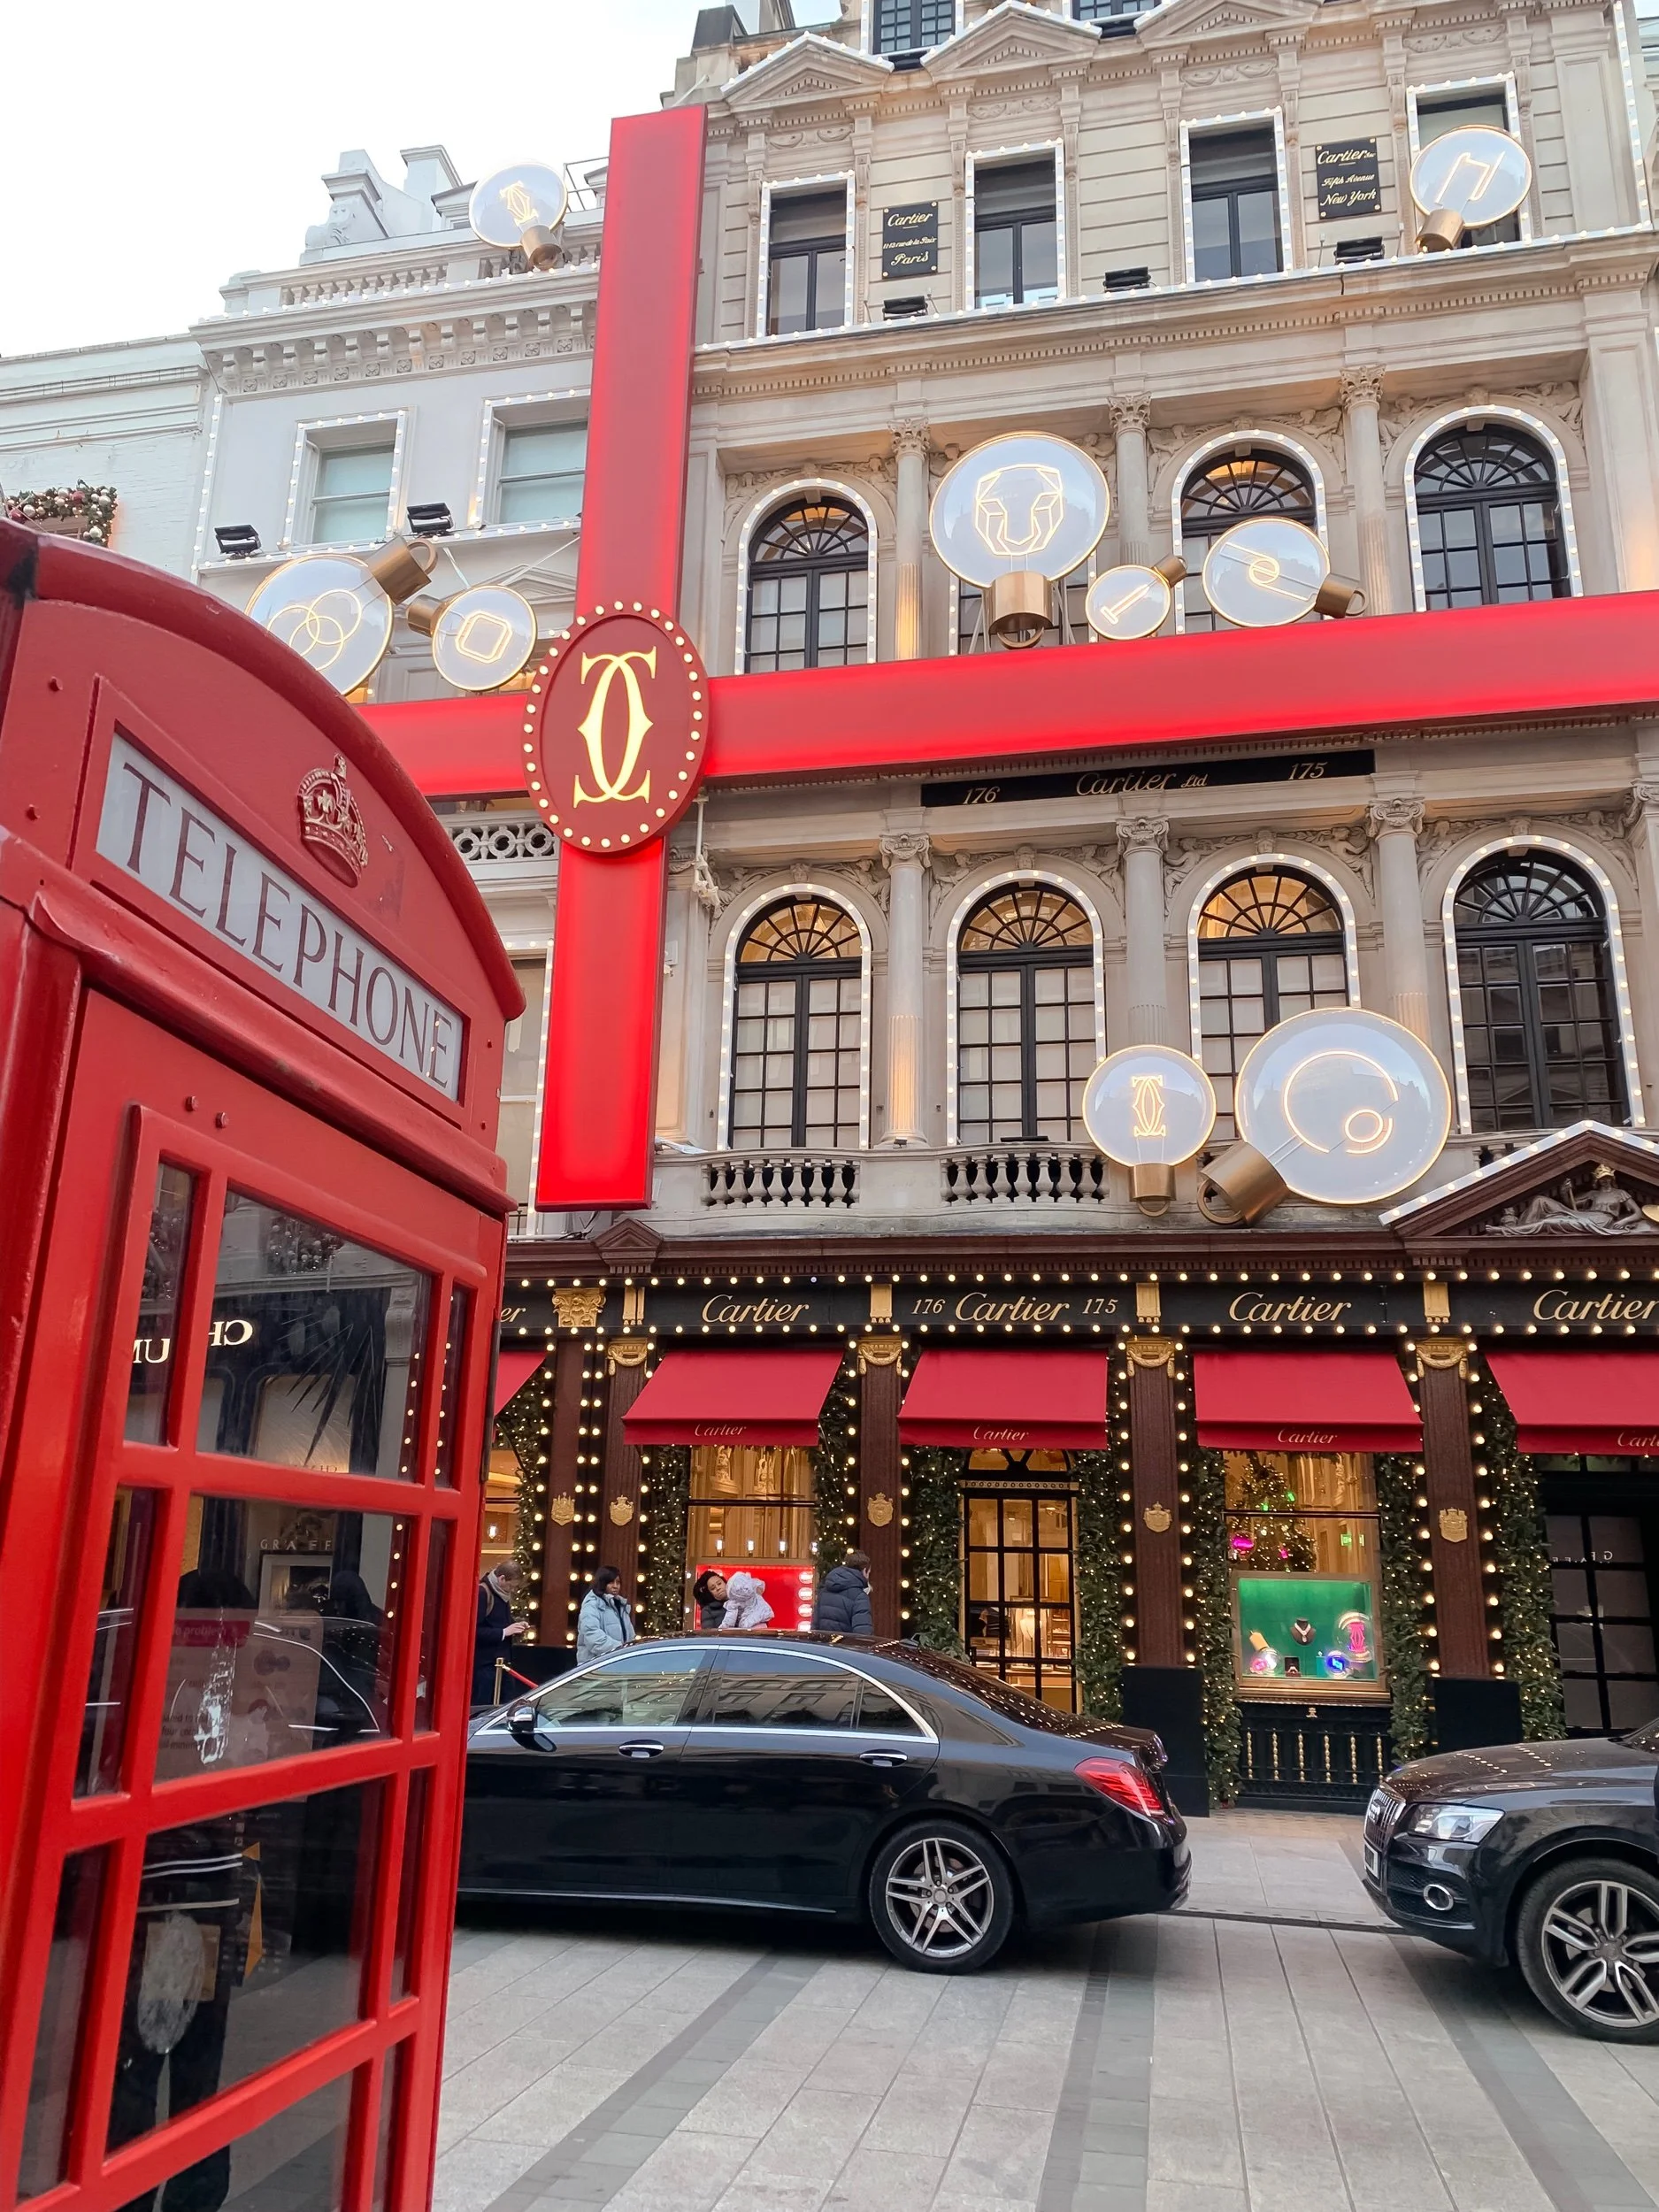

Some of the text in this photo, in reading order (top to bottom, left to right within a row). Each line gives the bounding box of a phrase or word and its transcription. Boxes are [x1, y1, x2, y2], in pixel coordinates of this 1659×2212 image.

[1317, 149, 1368, 165] Cartier
[1321, 173, 1375, 188] Fifth Avenue
[1319, 188, 1377, 207] New York
[887, 212, 933, 227] Cartier
[890, 250, 929, 266] Paris
[963, 761, 1329, 805] 176 Cartier Ltd 175
[122, 761, 455, 1089] TELEPHONE
[701, 1293, 810, 1325] Cartier
[910, 1291, 1119, 1323] 176 Cartier 175
[1228, 1291, 1353, 1323] Cartier
[1532, 1289, 1659, 1320] Cartier
[694, 1424, 748, 1438] Cartier
[972, 1425, 1031, 1442] Cartier
[1277, 1427, 1339, 1446] Cartier
[1617, 1431, 1659, 1448] Cart
